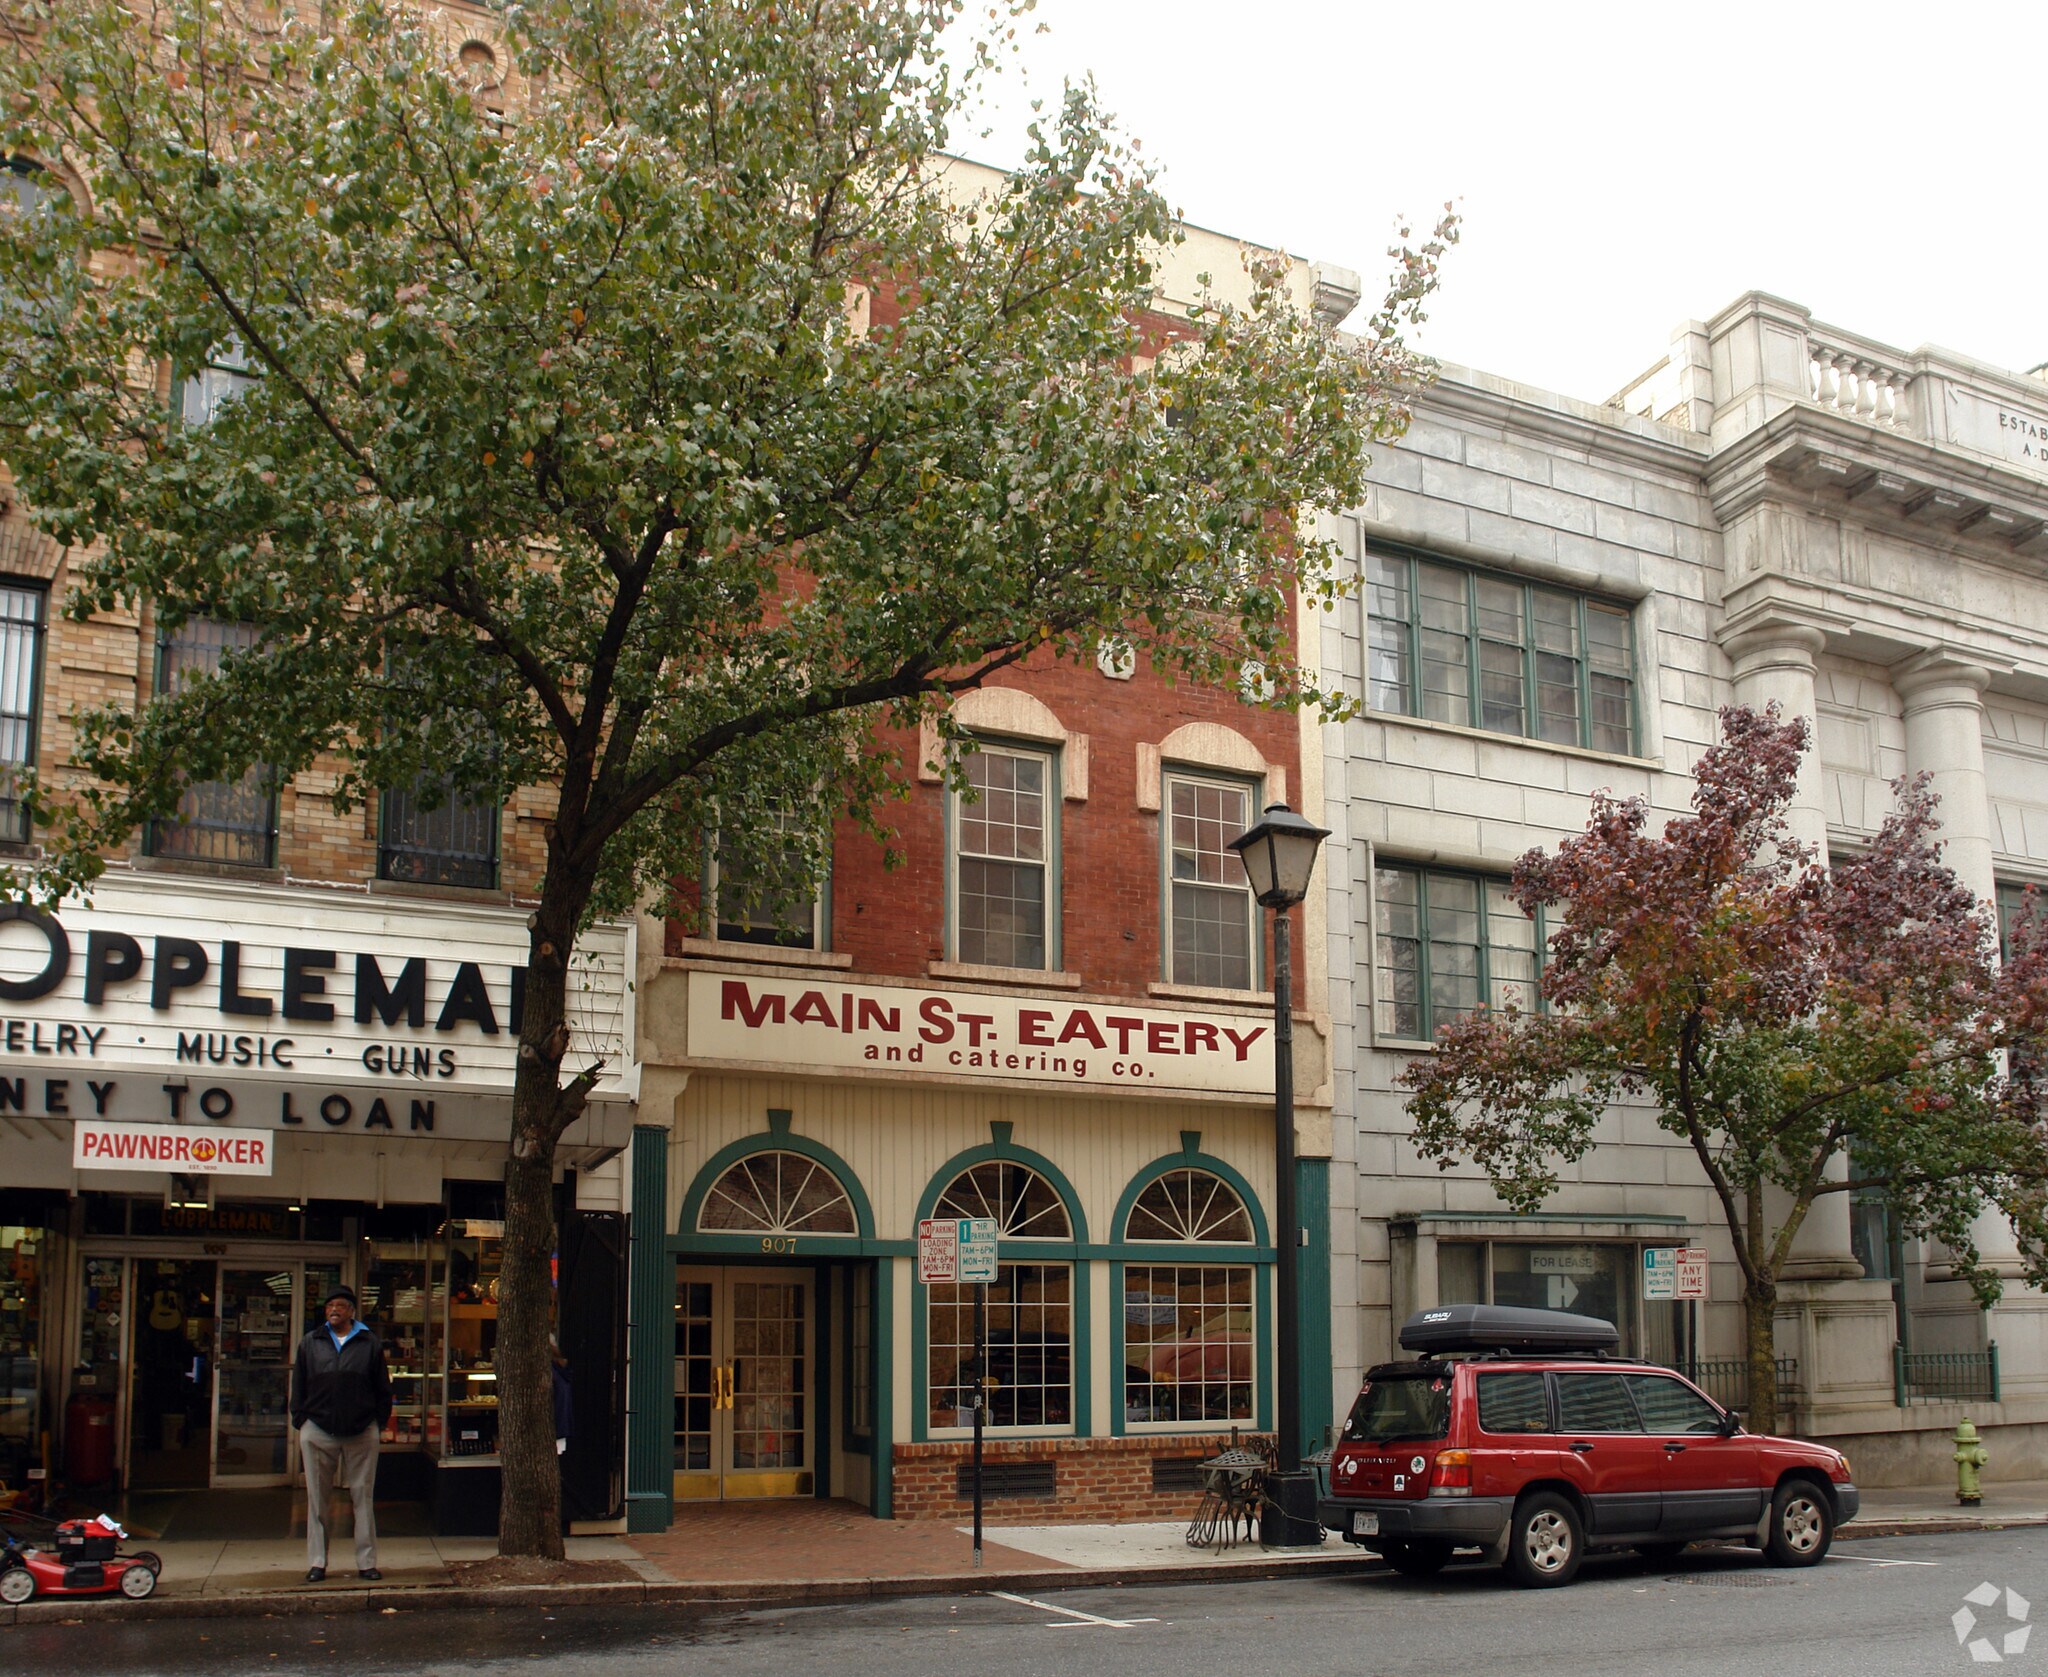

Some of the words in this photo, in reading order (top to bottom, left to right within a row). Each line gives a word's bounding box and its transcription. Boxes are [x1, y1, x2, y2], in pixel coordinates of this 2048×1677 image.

[0, 902, 528, 1035] OPPLEMA
[720, 979, 902, 1034] MAIN
[918, 996, 997, 1047] ST.
[1018, 1008, 1268, 1062] EATERY
[0, 1019, 107, 1055] ELRY
[177, 1032, 294, 1067] MUSIC
[362, 1044, 456, 1078] GUNS
[863, 1041, 924, 1063] and
[948, 1046, 1088, 1078] catering
[1112, 1059, 1156, 1078] co.
[164, 1084, 234, 1120] TO
[282, 1092, 436, 1131] LOAN
[82, 1131, 265, 1166] PAWNBROKER
[920, 1224, 931, 1236] NO
[931, 1225, 955, 1234] PARKING
[963, 1224, 968, 1240] 1
[971, 1232, 994, 1240] PARKING
[761, 1237, 797, 1254] 907
[923, 1239, 953, 1247] LOADING
[929, 1247, 947, 1255] ZONE
[922, 1256, 955, 1264] 7AM-6PM
[962, 1257, 993, 1265] MON-FRI
[1533, 1257, 1555, 1267] FOR
[1559, 1257, 1592, 1268] LEASE
[923, 1264, 953, 1272] MON-FRI
[1682, 1265, 1702, 1275] ANY
[1681, 1277, 1703, 1286] TIME
